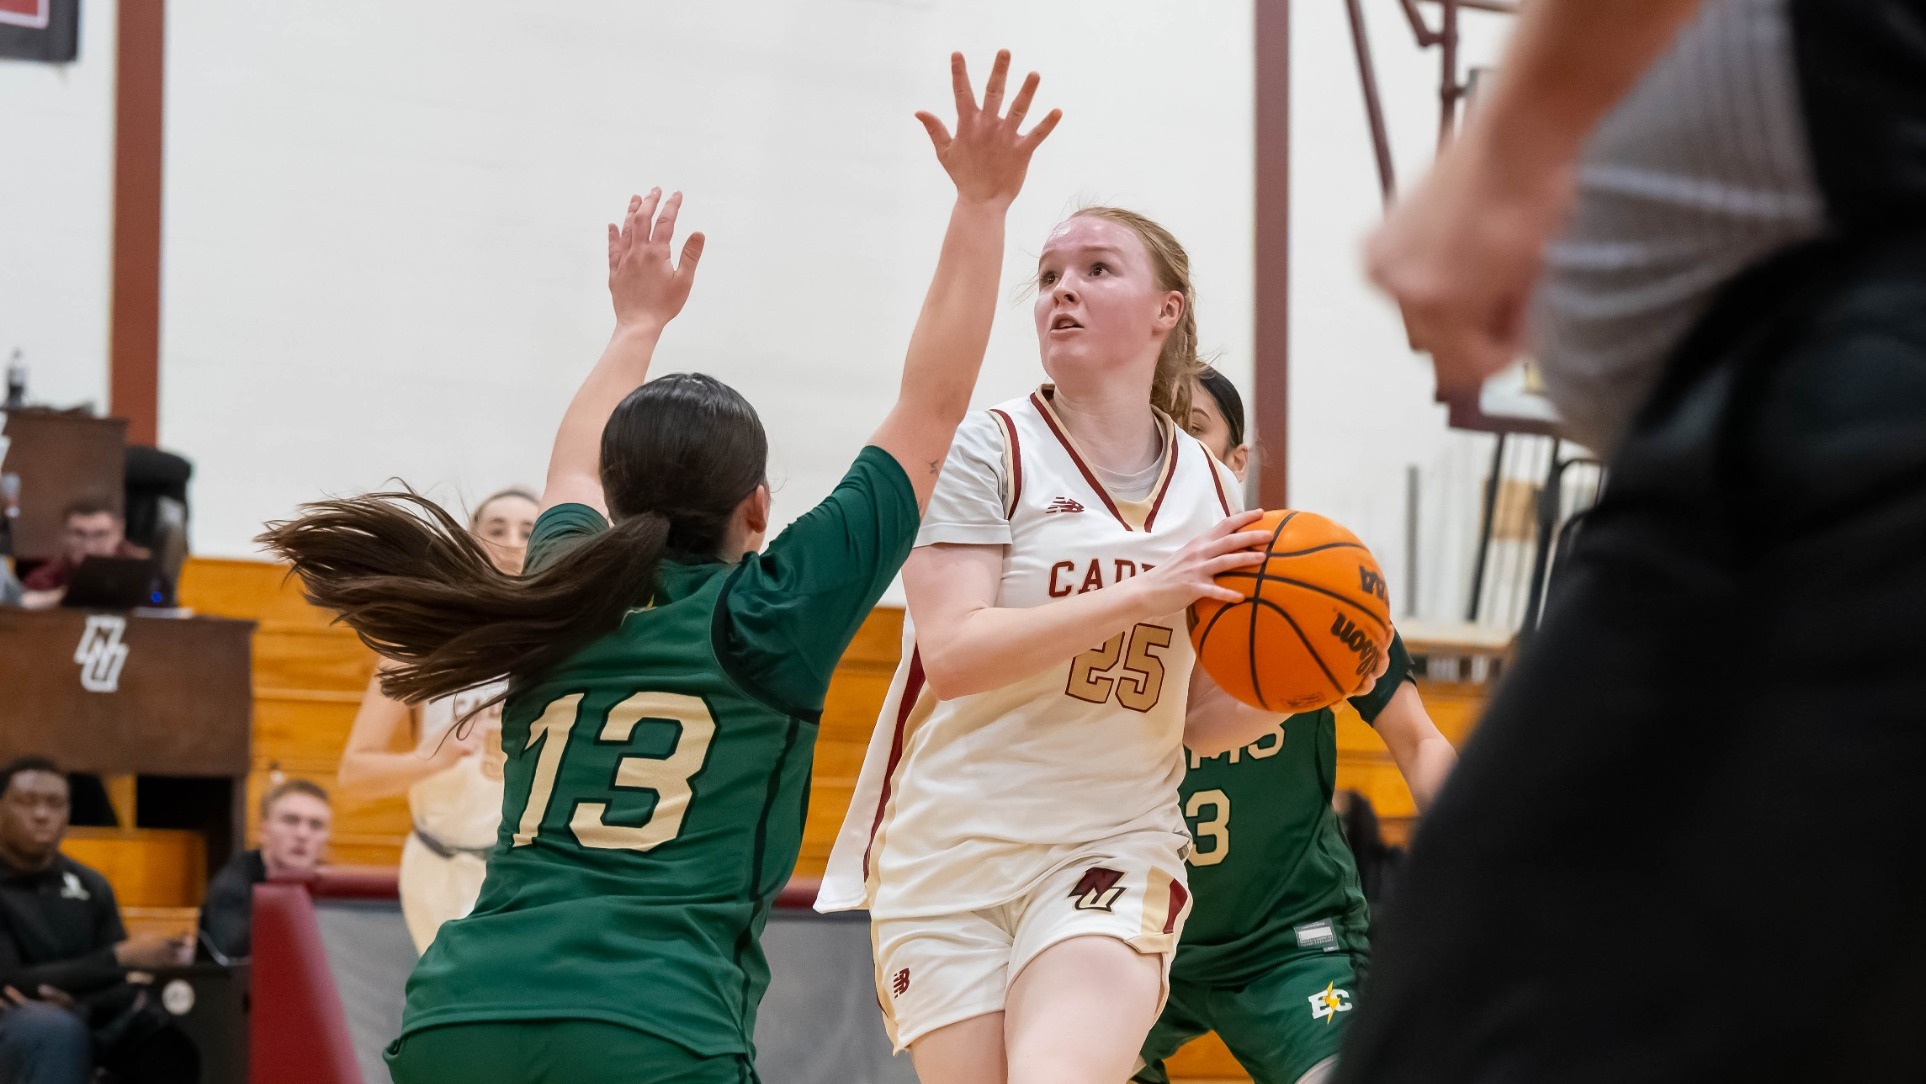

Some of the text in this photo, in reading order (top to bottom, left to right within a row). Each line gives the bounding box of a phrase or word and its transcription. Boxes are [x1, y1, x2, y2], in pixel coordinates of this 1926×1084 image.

[1048, 558, 1156, 598] CAD
[1064, 622, 1173, 714] 25
[511, 688, 718, 852] 13
[1185, 788, 1231, 868] 3
[1307, 988, 1353, 1020] EC
